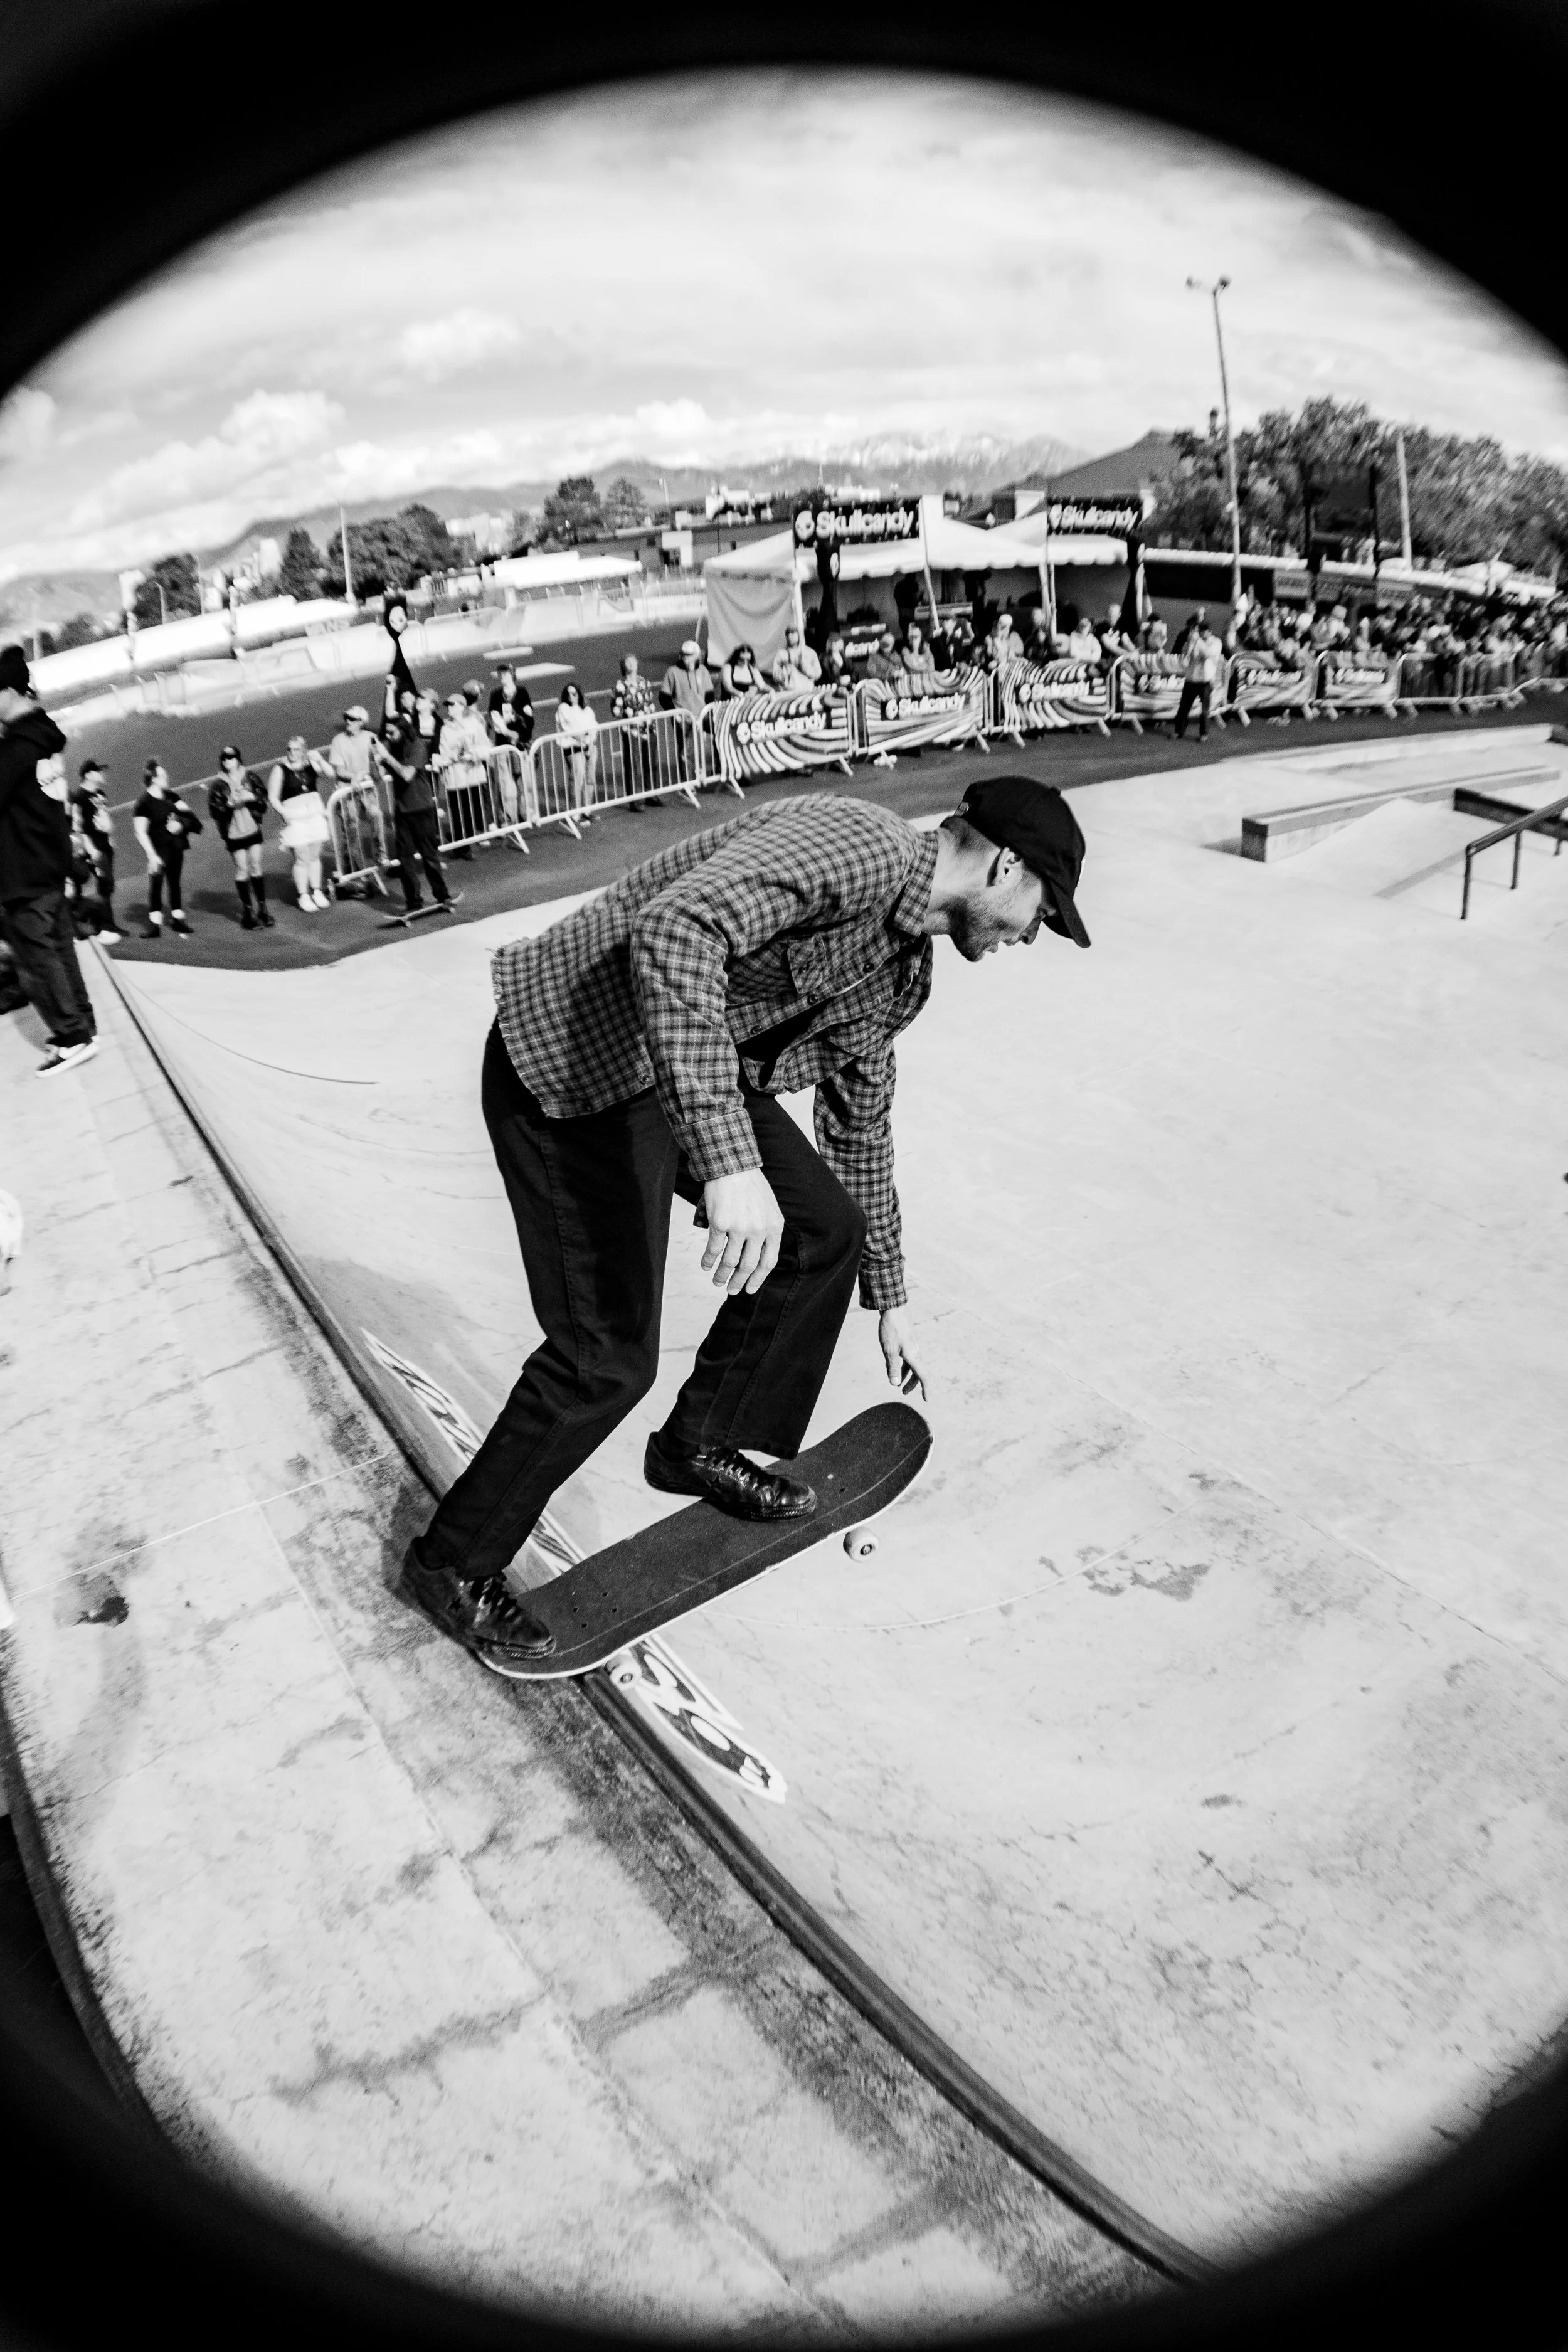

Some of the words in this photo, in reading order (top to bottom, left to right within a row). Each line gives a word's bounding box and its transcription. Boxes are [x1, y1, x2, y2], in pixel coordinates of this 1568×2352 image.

[816, 507, 914, 538] Skullcandy
[1061, 505, 1138, 532] Skullcandy
[304, 618, 350, 637] VANS
[898, 692, 966, 719] Skullcandy
[751, 711, 827, 743] Skullcandy
